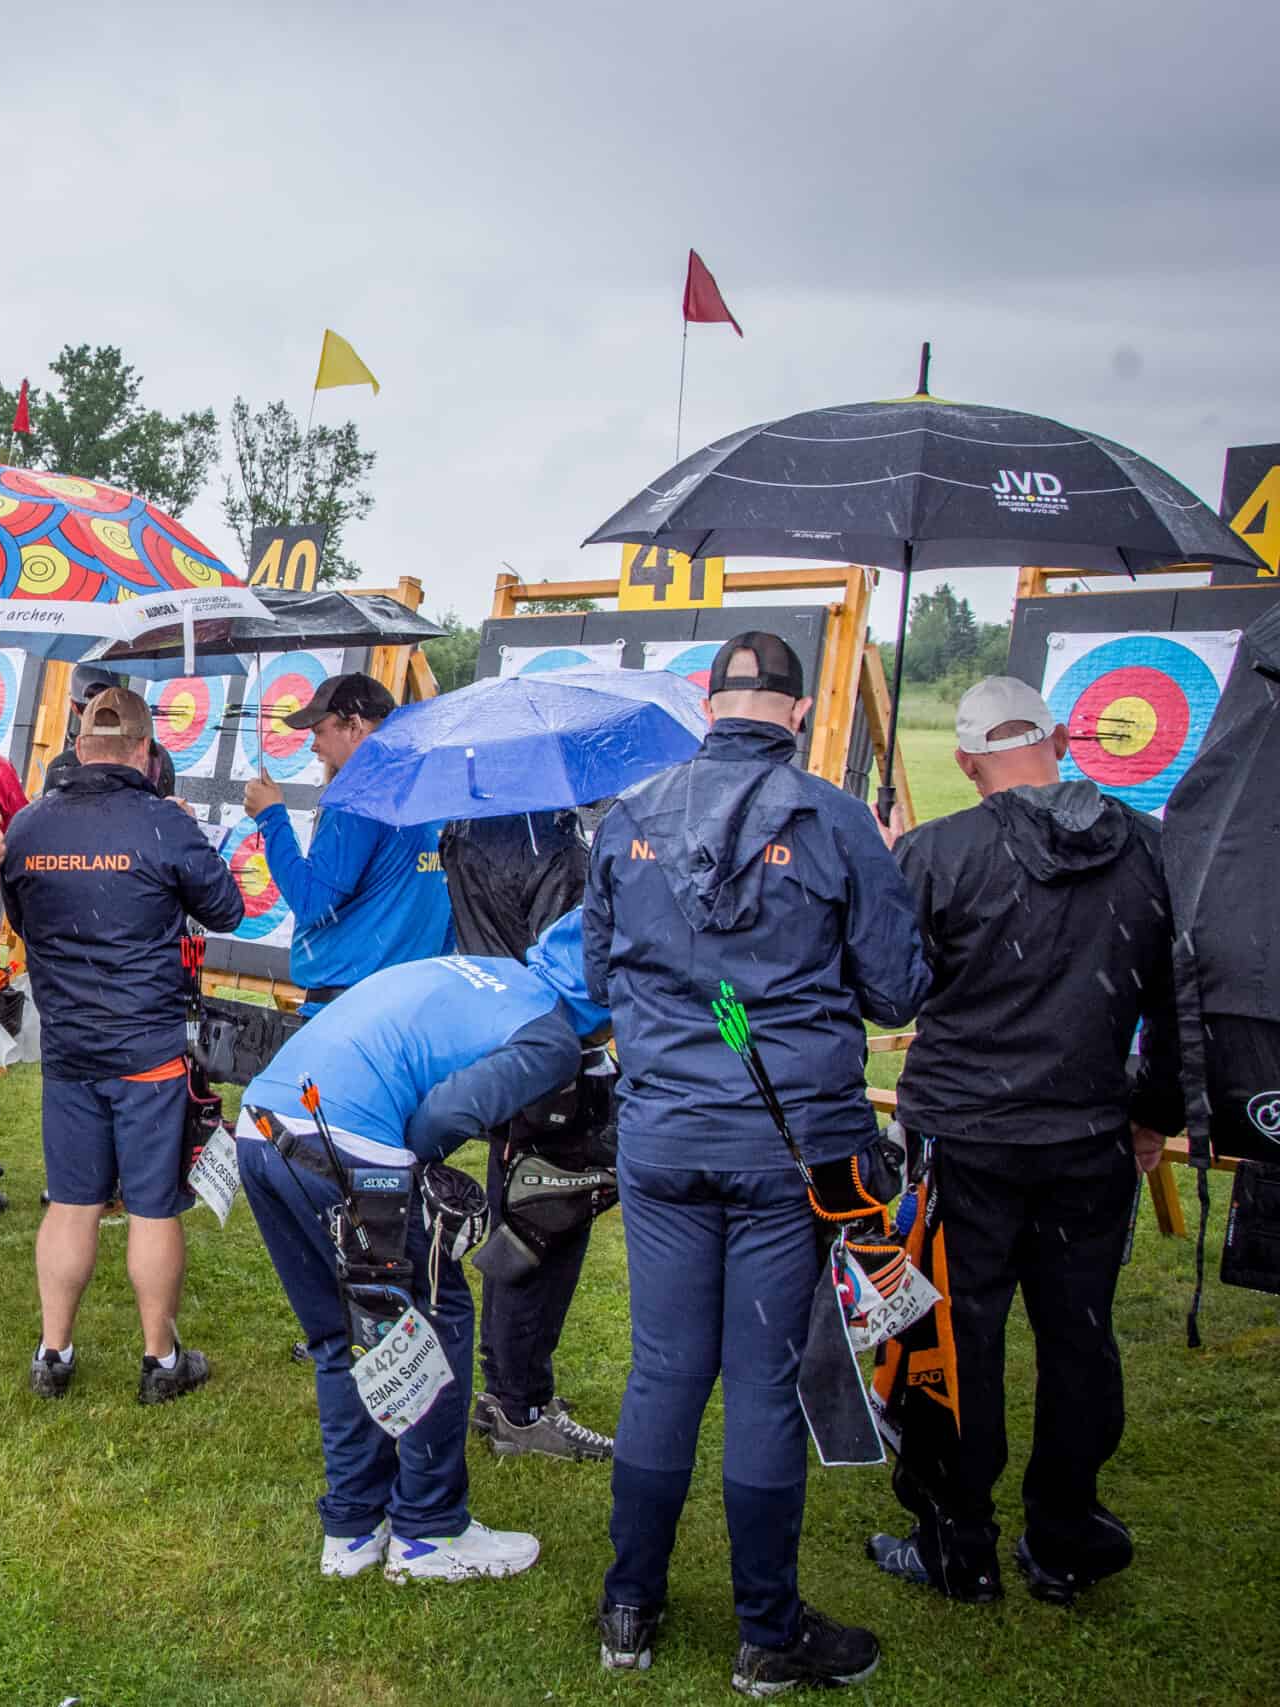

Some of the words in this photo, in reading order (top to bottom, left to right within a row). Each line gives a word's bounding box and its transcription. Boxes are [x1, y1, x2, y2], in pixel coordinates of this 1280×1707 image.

[991, 469, 1062, 496] JVD
[249, 538, 317, 593] 40
[628, 543, 707, 602] 41
[6, 607, 65, 625] archery.
[24, 854, 132, 871] NEDERLAND
[540, 1174, 601, 1187] EASTON
[365, 1375, 403, 1410] ZEMAN
[399, 1334, 439, 1380] Samuel
[375, 1335, 410, 1374] 42C
[386, 1372, 430, 1415] Slovakia
